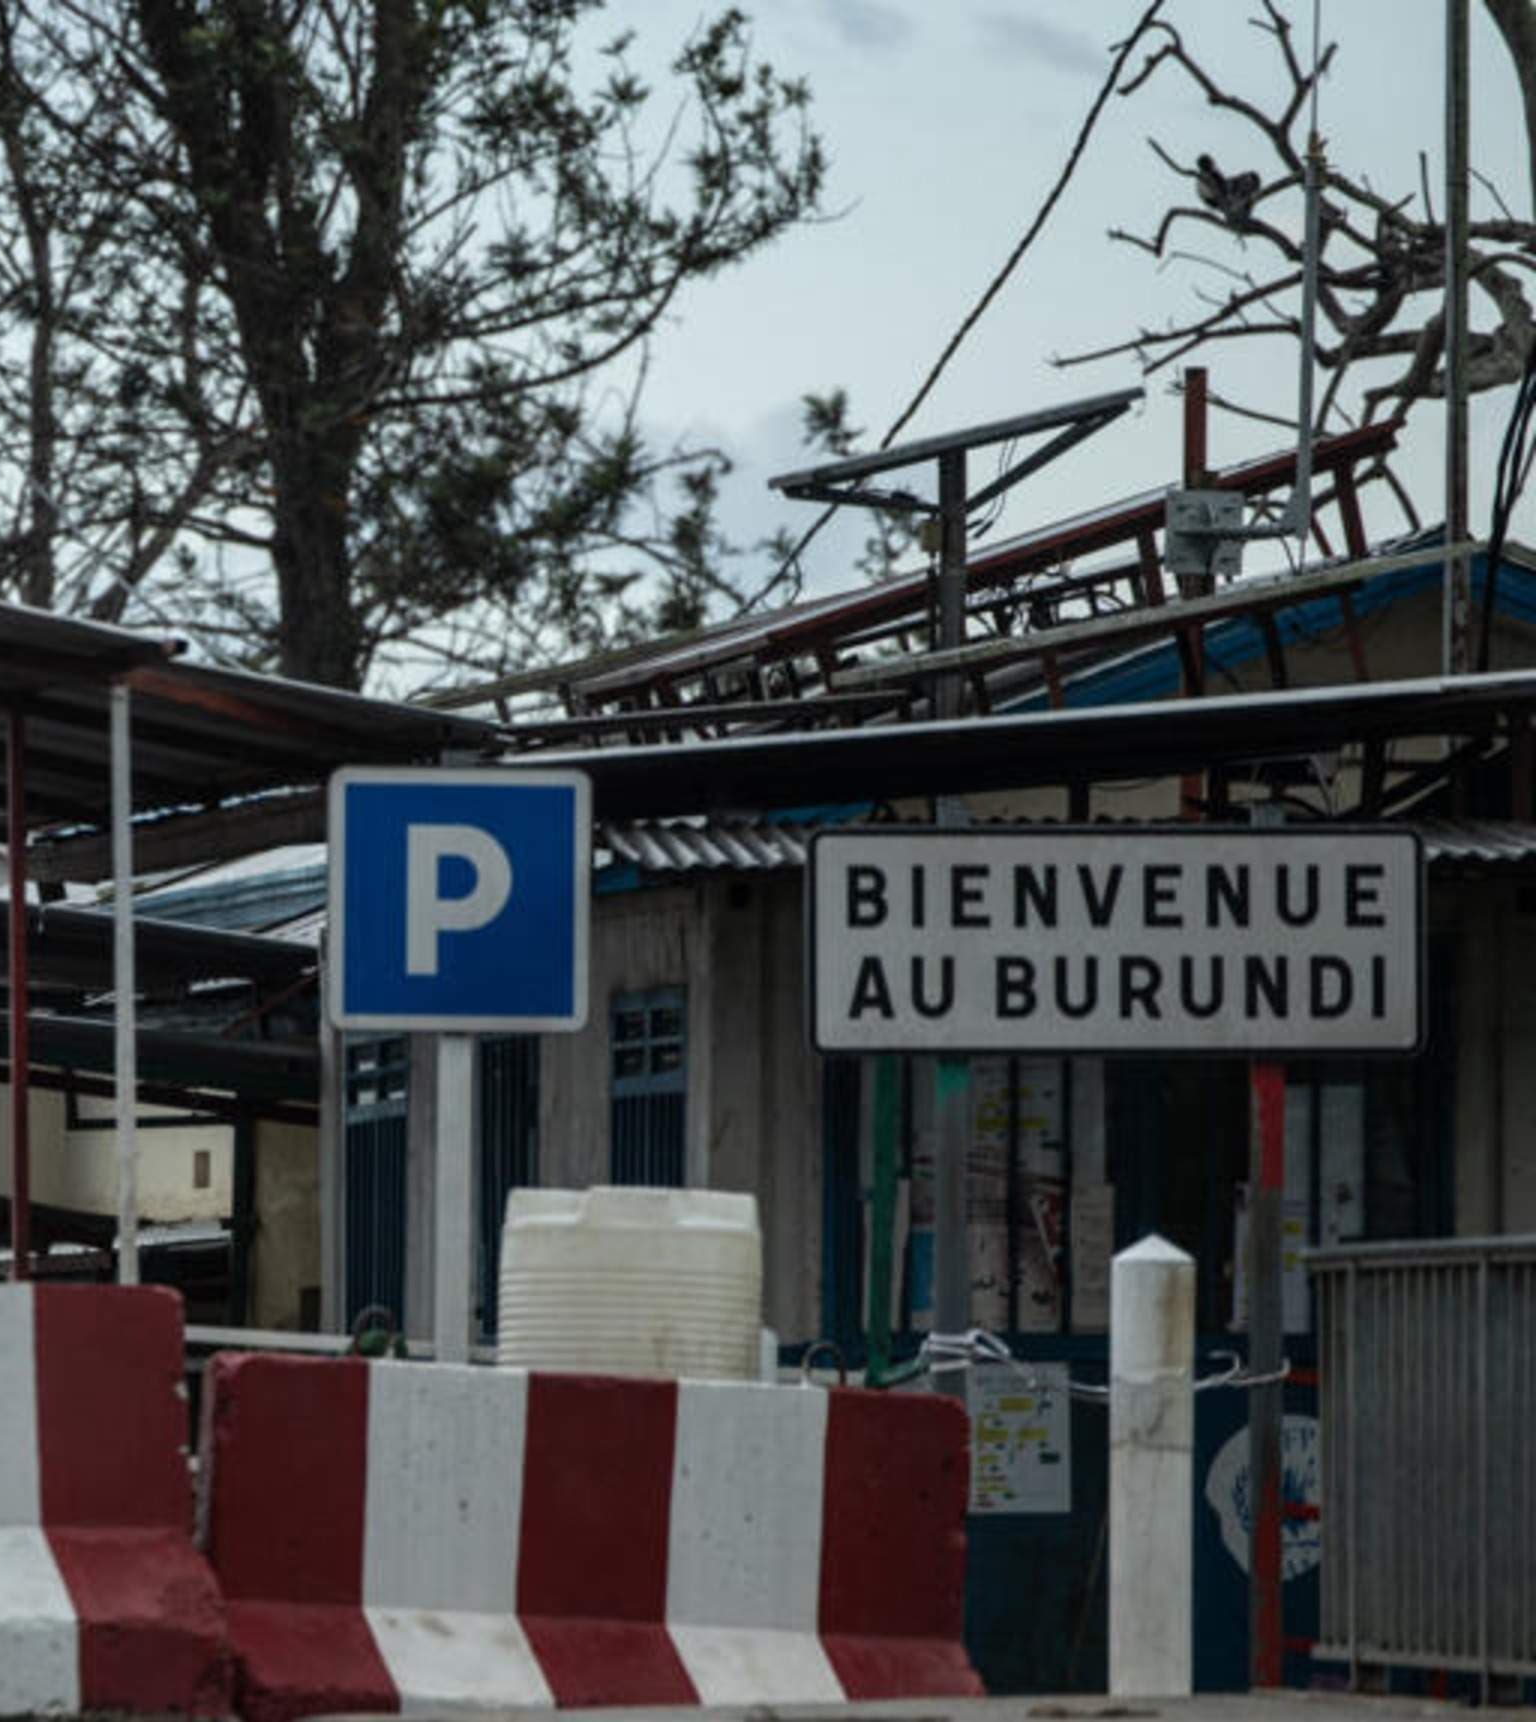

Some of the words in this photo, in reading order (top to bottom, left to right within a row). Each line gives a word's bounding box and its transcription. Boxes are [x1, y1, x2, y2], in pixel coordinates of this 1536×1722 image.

[406, 823, 513, 975] P
[846, 863, 1387, 929] BIENVENUE
[848, 955, 955, 1019] AU
[995, 954, 1386, 1020] BURUNDI
